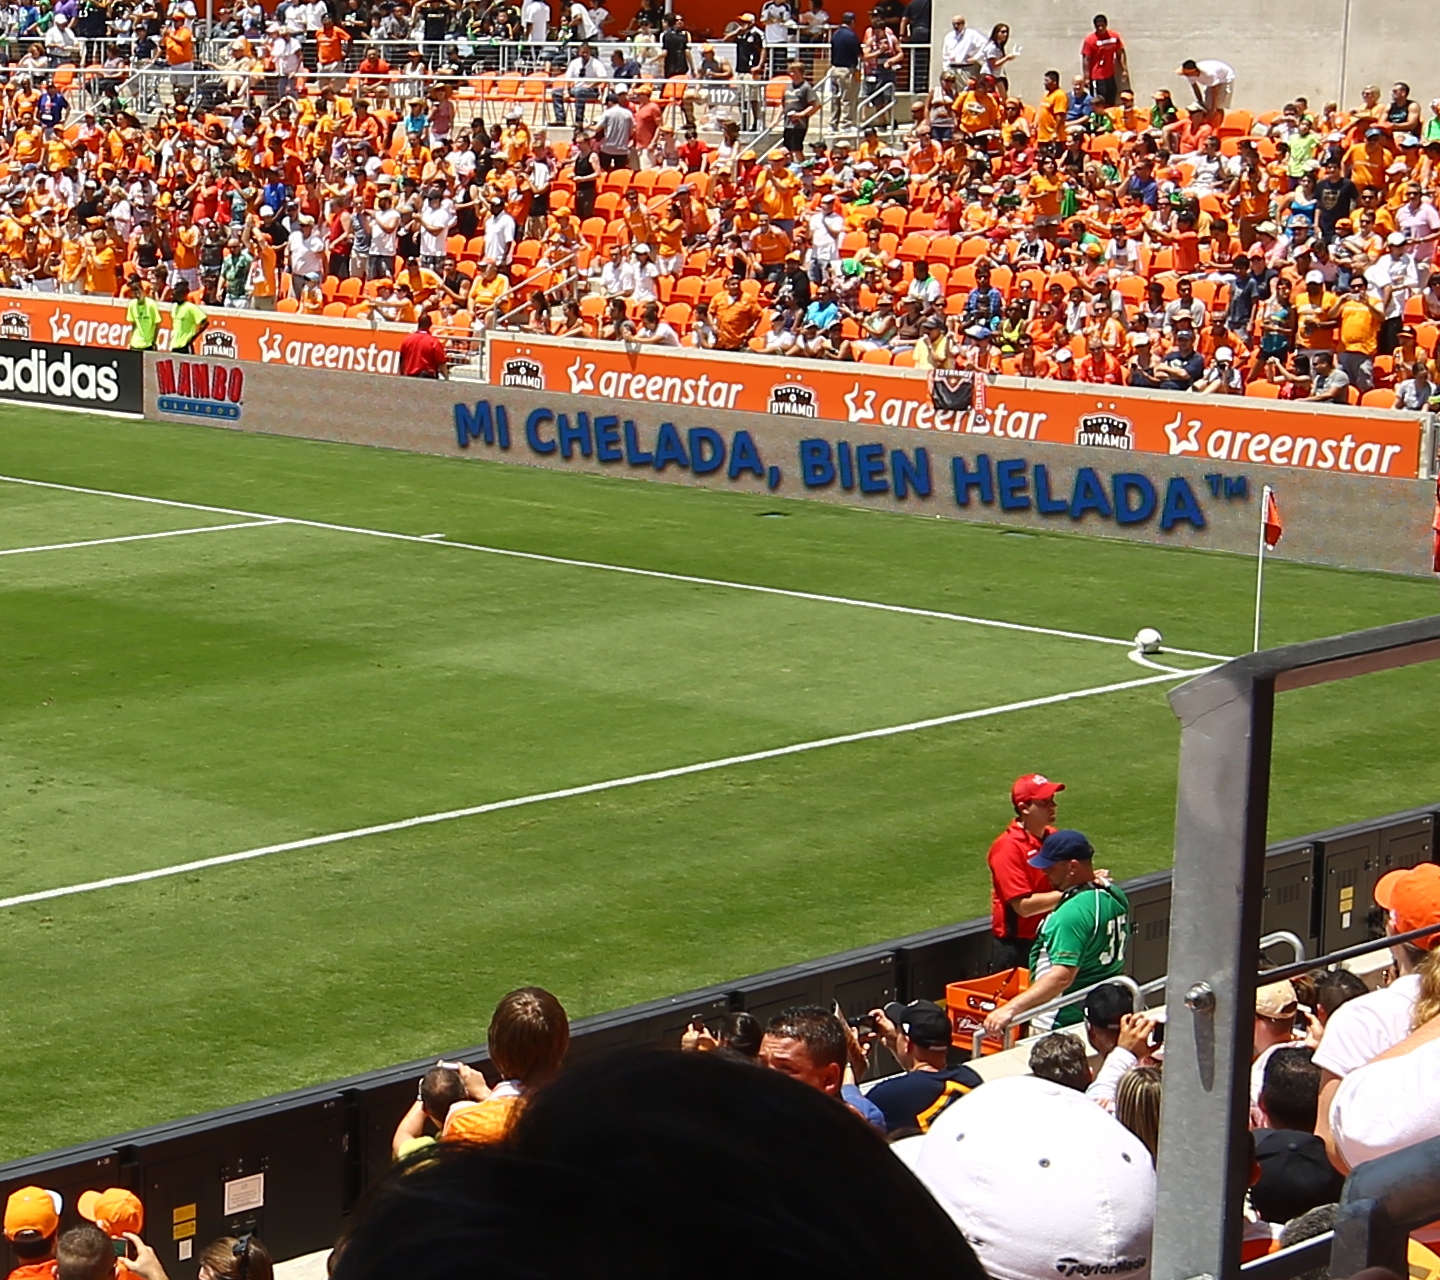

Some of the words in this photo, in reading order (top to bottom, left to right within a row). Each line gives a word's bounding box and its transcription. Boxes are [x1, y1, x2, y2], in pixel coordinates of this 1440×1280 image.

[394, 83, 410, 96] 116
[710, 89, 728, 103] 117
[156, 360, 243, 403] MAMBO
[505, 374, 541, 389] DYNAMO
[599, 370, 742, 408] greenstar
[772, 401, 815, 417] DYNAMO
[454, 400, 511, 449] MI
[526, 408, 781, 497] CHELADA,
[800, 437, 932, 500] BIEN
[1080, 432, 1128, 449] DYNAMO
[1207, 428, 1400, 474] greenstar
[1056, 1256, 1146, 1278] TaylorMade
